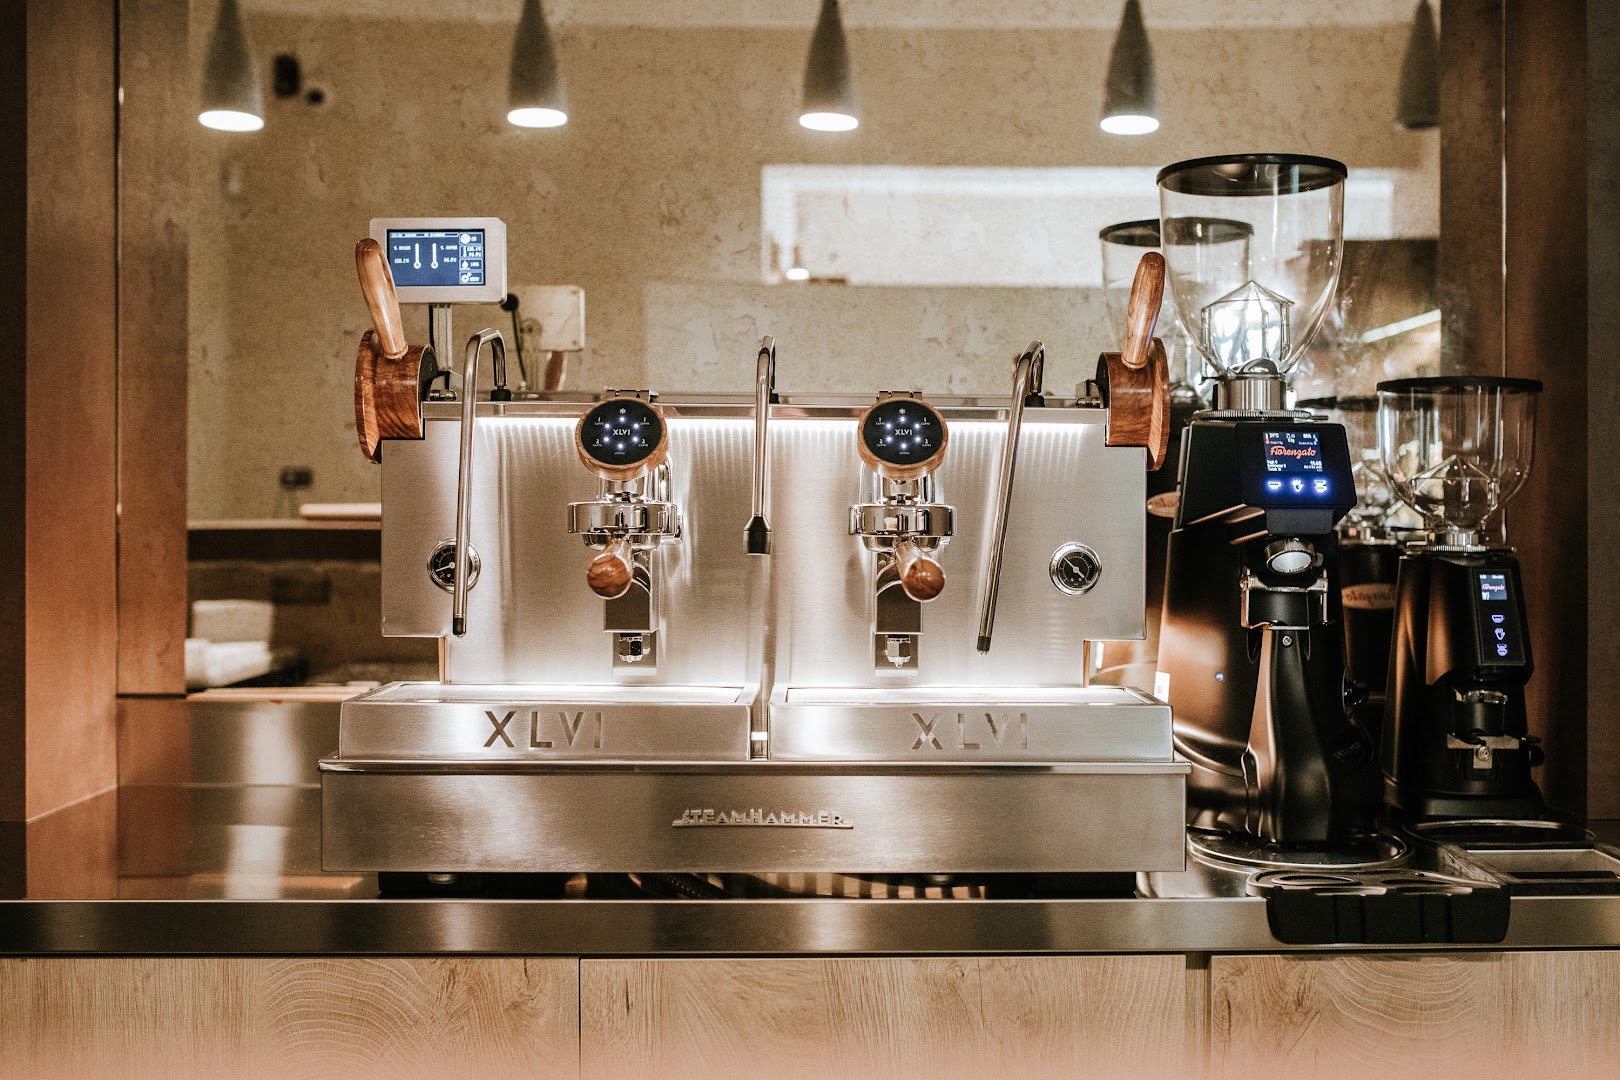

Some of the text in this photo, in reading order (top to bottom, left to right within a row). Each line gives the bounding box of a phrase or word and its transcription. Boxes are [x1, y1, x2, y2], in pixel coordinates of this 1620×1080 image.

[1270, 445, 1316, 459] Fiorenzato
[483, 711, 602, 748] XLVI
[911, 712, 1028, 750] XLVI
